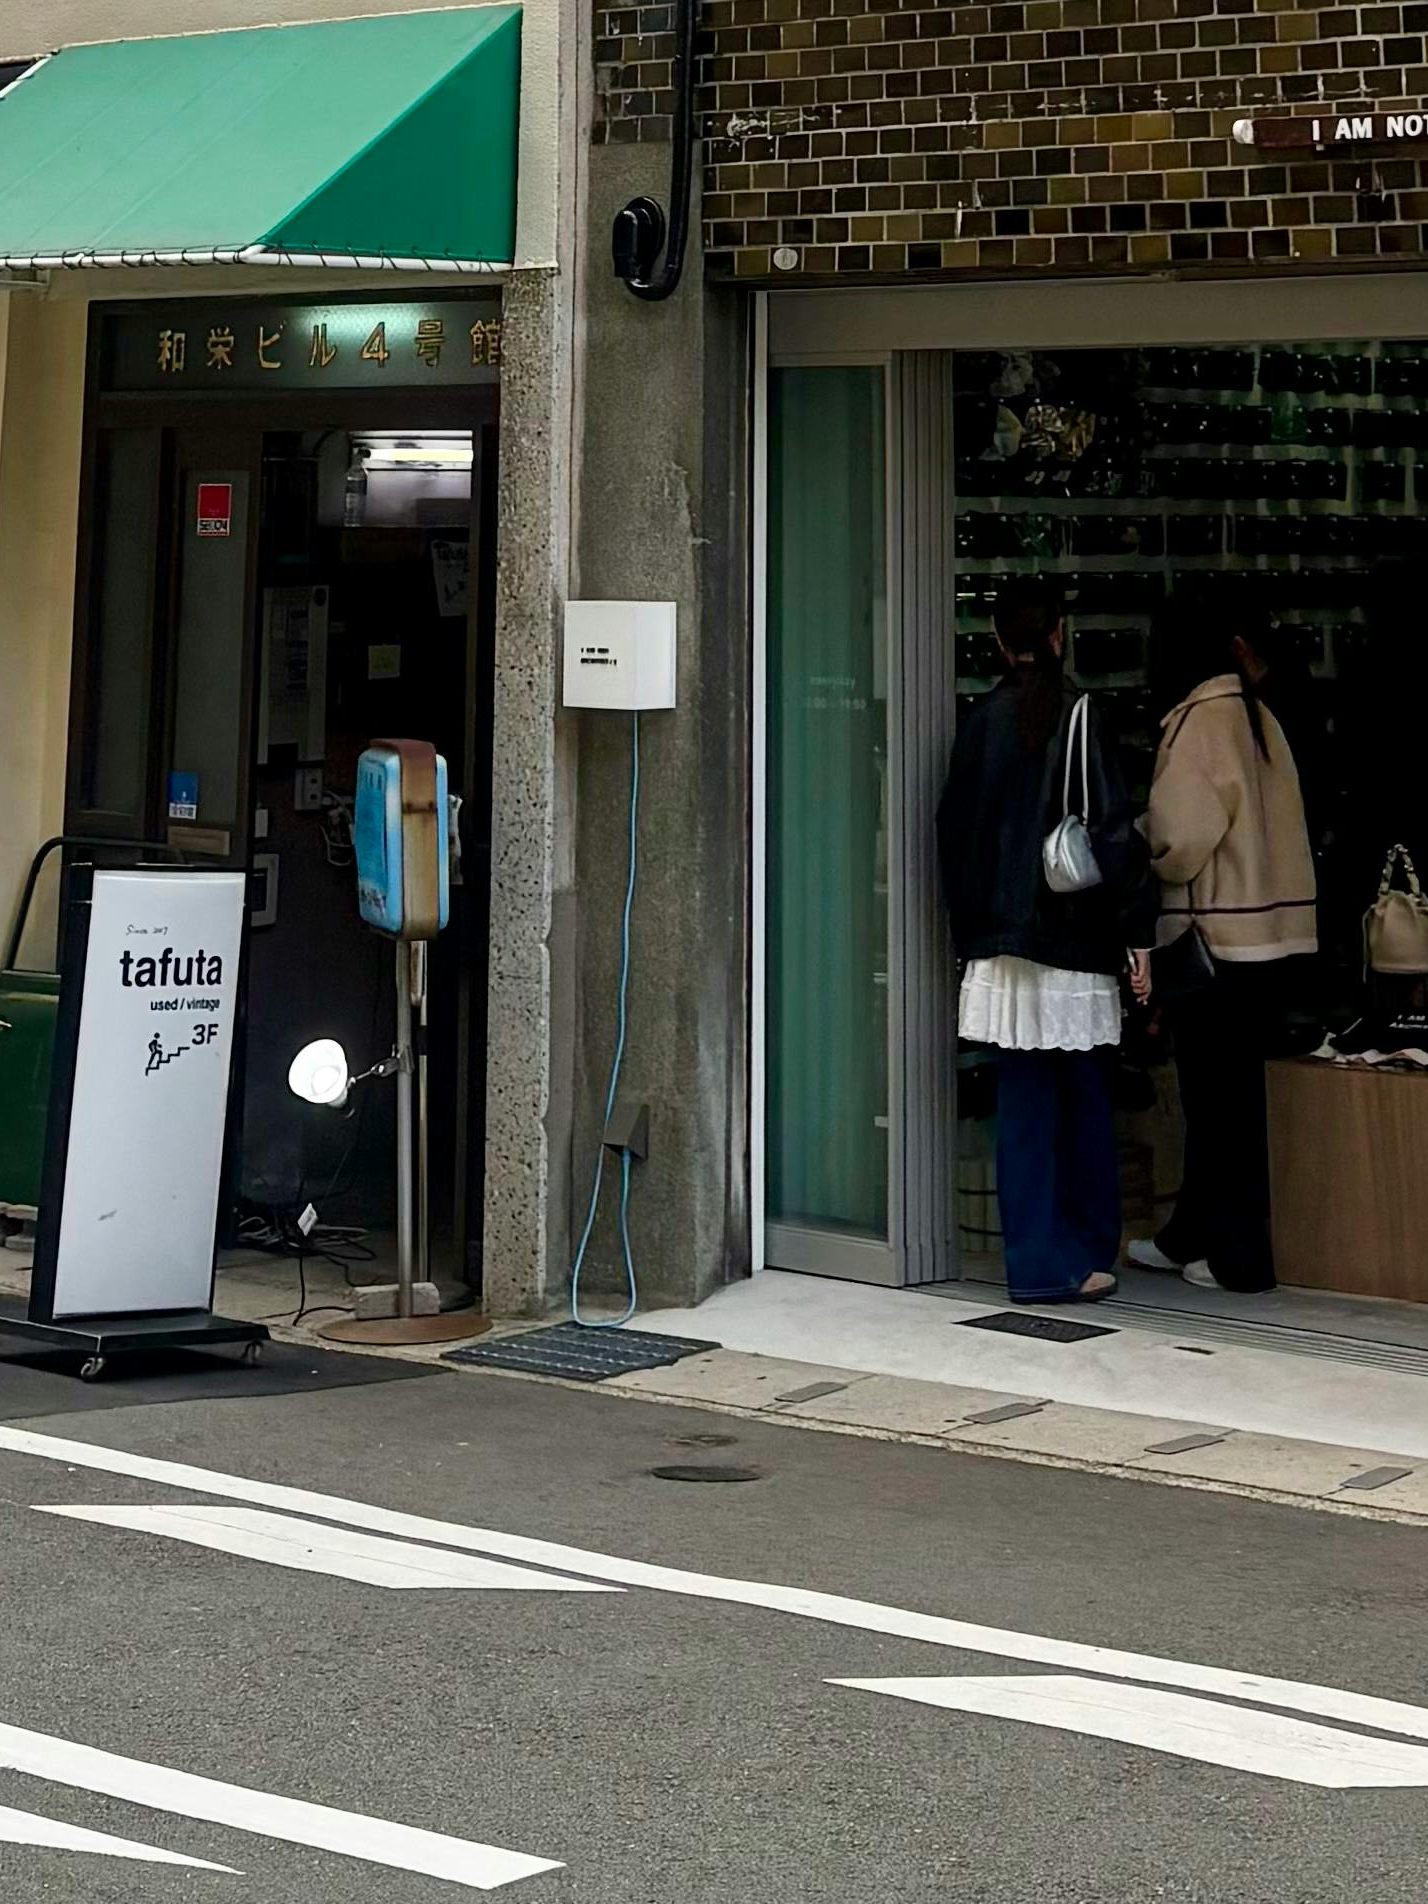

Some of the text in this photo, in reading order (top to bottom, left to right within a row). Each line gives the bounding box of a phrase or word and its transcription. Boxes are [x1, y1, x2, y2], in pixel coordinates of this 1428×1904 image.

[1312, 120, 1320, 141] I
[1334, 116, 1372, 140] AM
[120, 947, 223, 988] tafuta
[150, 998, 178, 1011] used
[187, 997, 220, 1012] vintage
[191, 1023, 219, 1045] 3F
